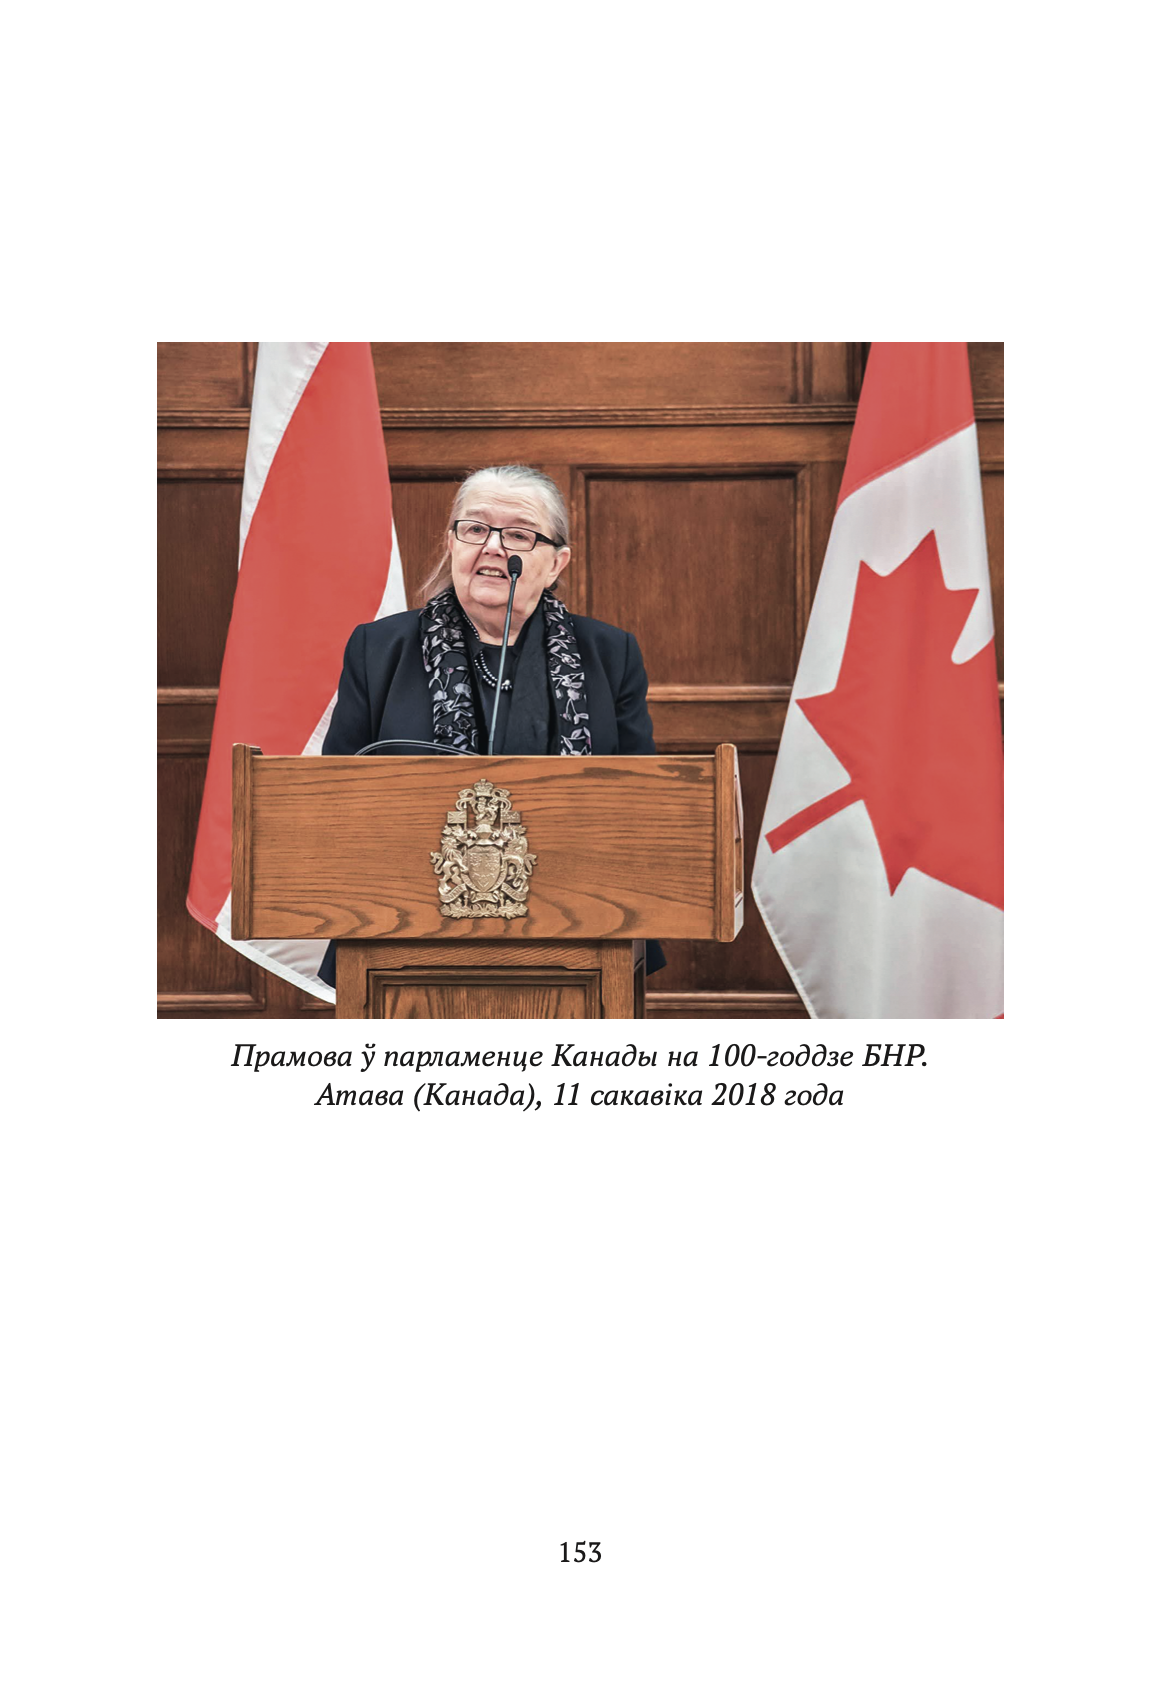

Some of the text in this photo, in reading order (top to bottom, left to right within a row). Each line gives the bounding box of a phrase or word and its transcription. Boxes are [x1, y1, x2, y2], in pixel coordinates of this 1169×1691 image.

[230, 1043, 927, 1073] Прамова ў парламенце Канады на 100-годдзе БНР.
[313, 1082, 844, 1112] Атава (Канада), 11 сакавіка 2018 года
[560, 1540, 602, 1563] 153
